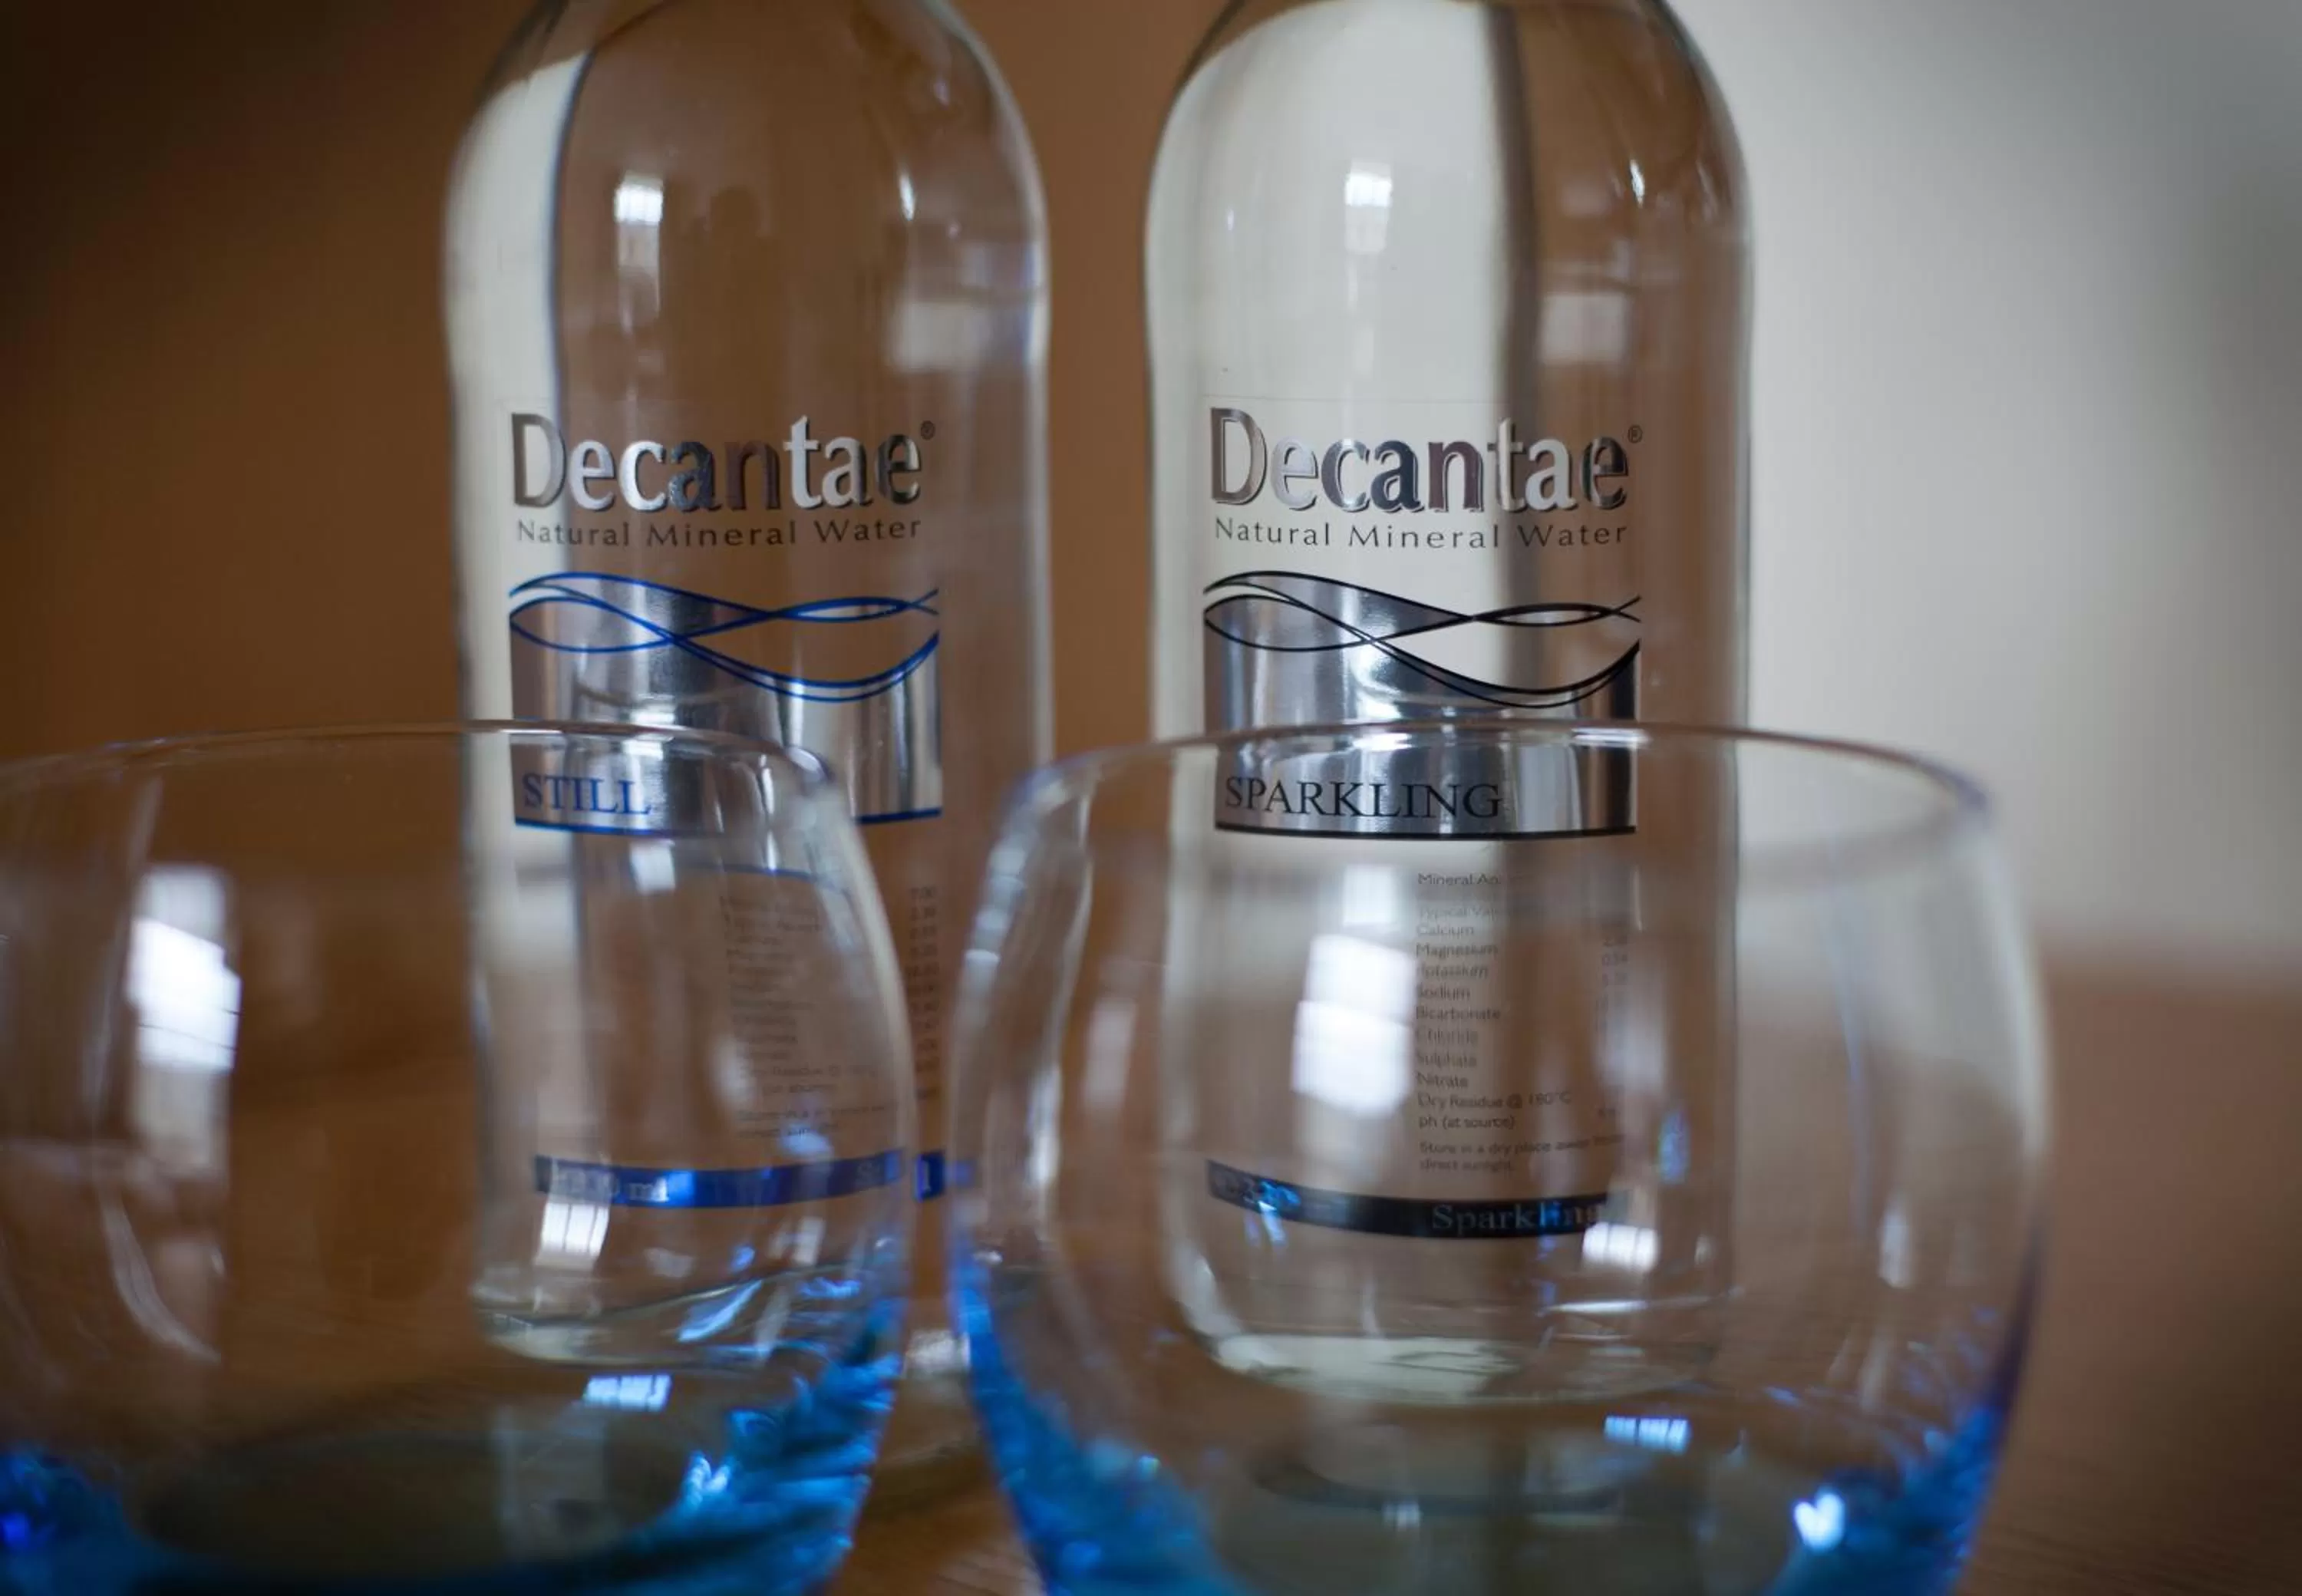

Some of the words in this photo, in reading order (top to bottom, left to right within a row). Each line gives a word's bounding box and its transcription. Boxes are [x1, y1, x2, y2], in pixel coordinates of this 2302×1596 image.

[516, 520, 630, 546] Natural
[646, 521, 796, 548] Mineral
[813, 519, 922, 543] Water
[1215, 517, 1331, 546] Natural
[1348, 523, 1499, 549] Mineral
[1517, 524, 1628, 549] Water
[522, 772, 652, 816] STILL
[1225, 775, 1503, 819] SPARKLING
[1417, 872, 1473, 885] Mineral
[1417, 1092, 1448, 1110] Dry
